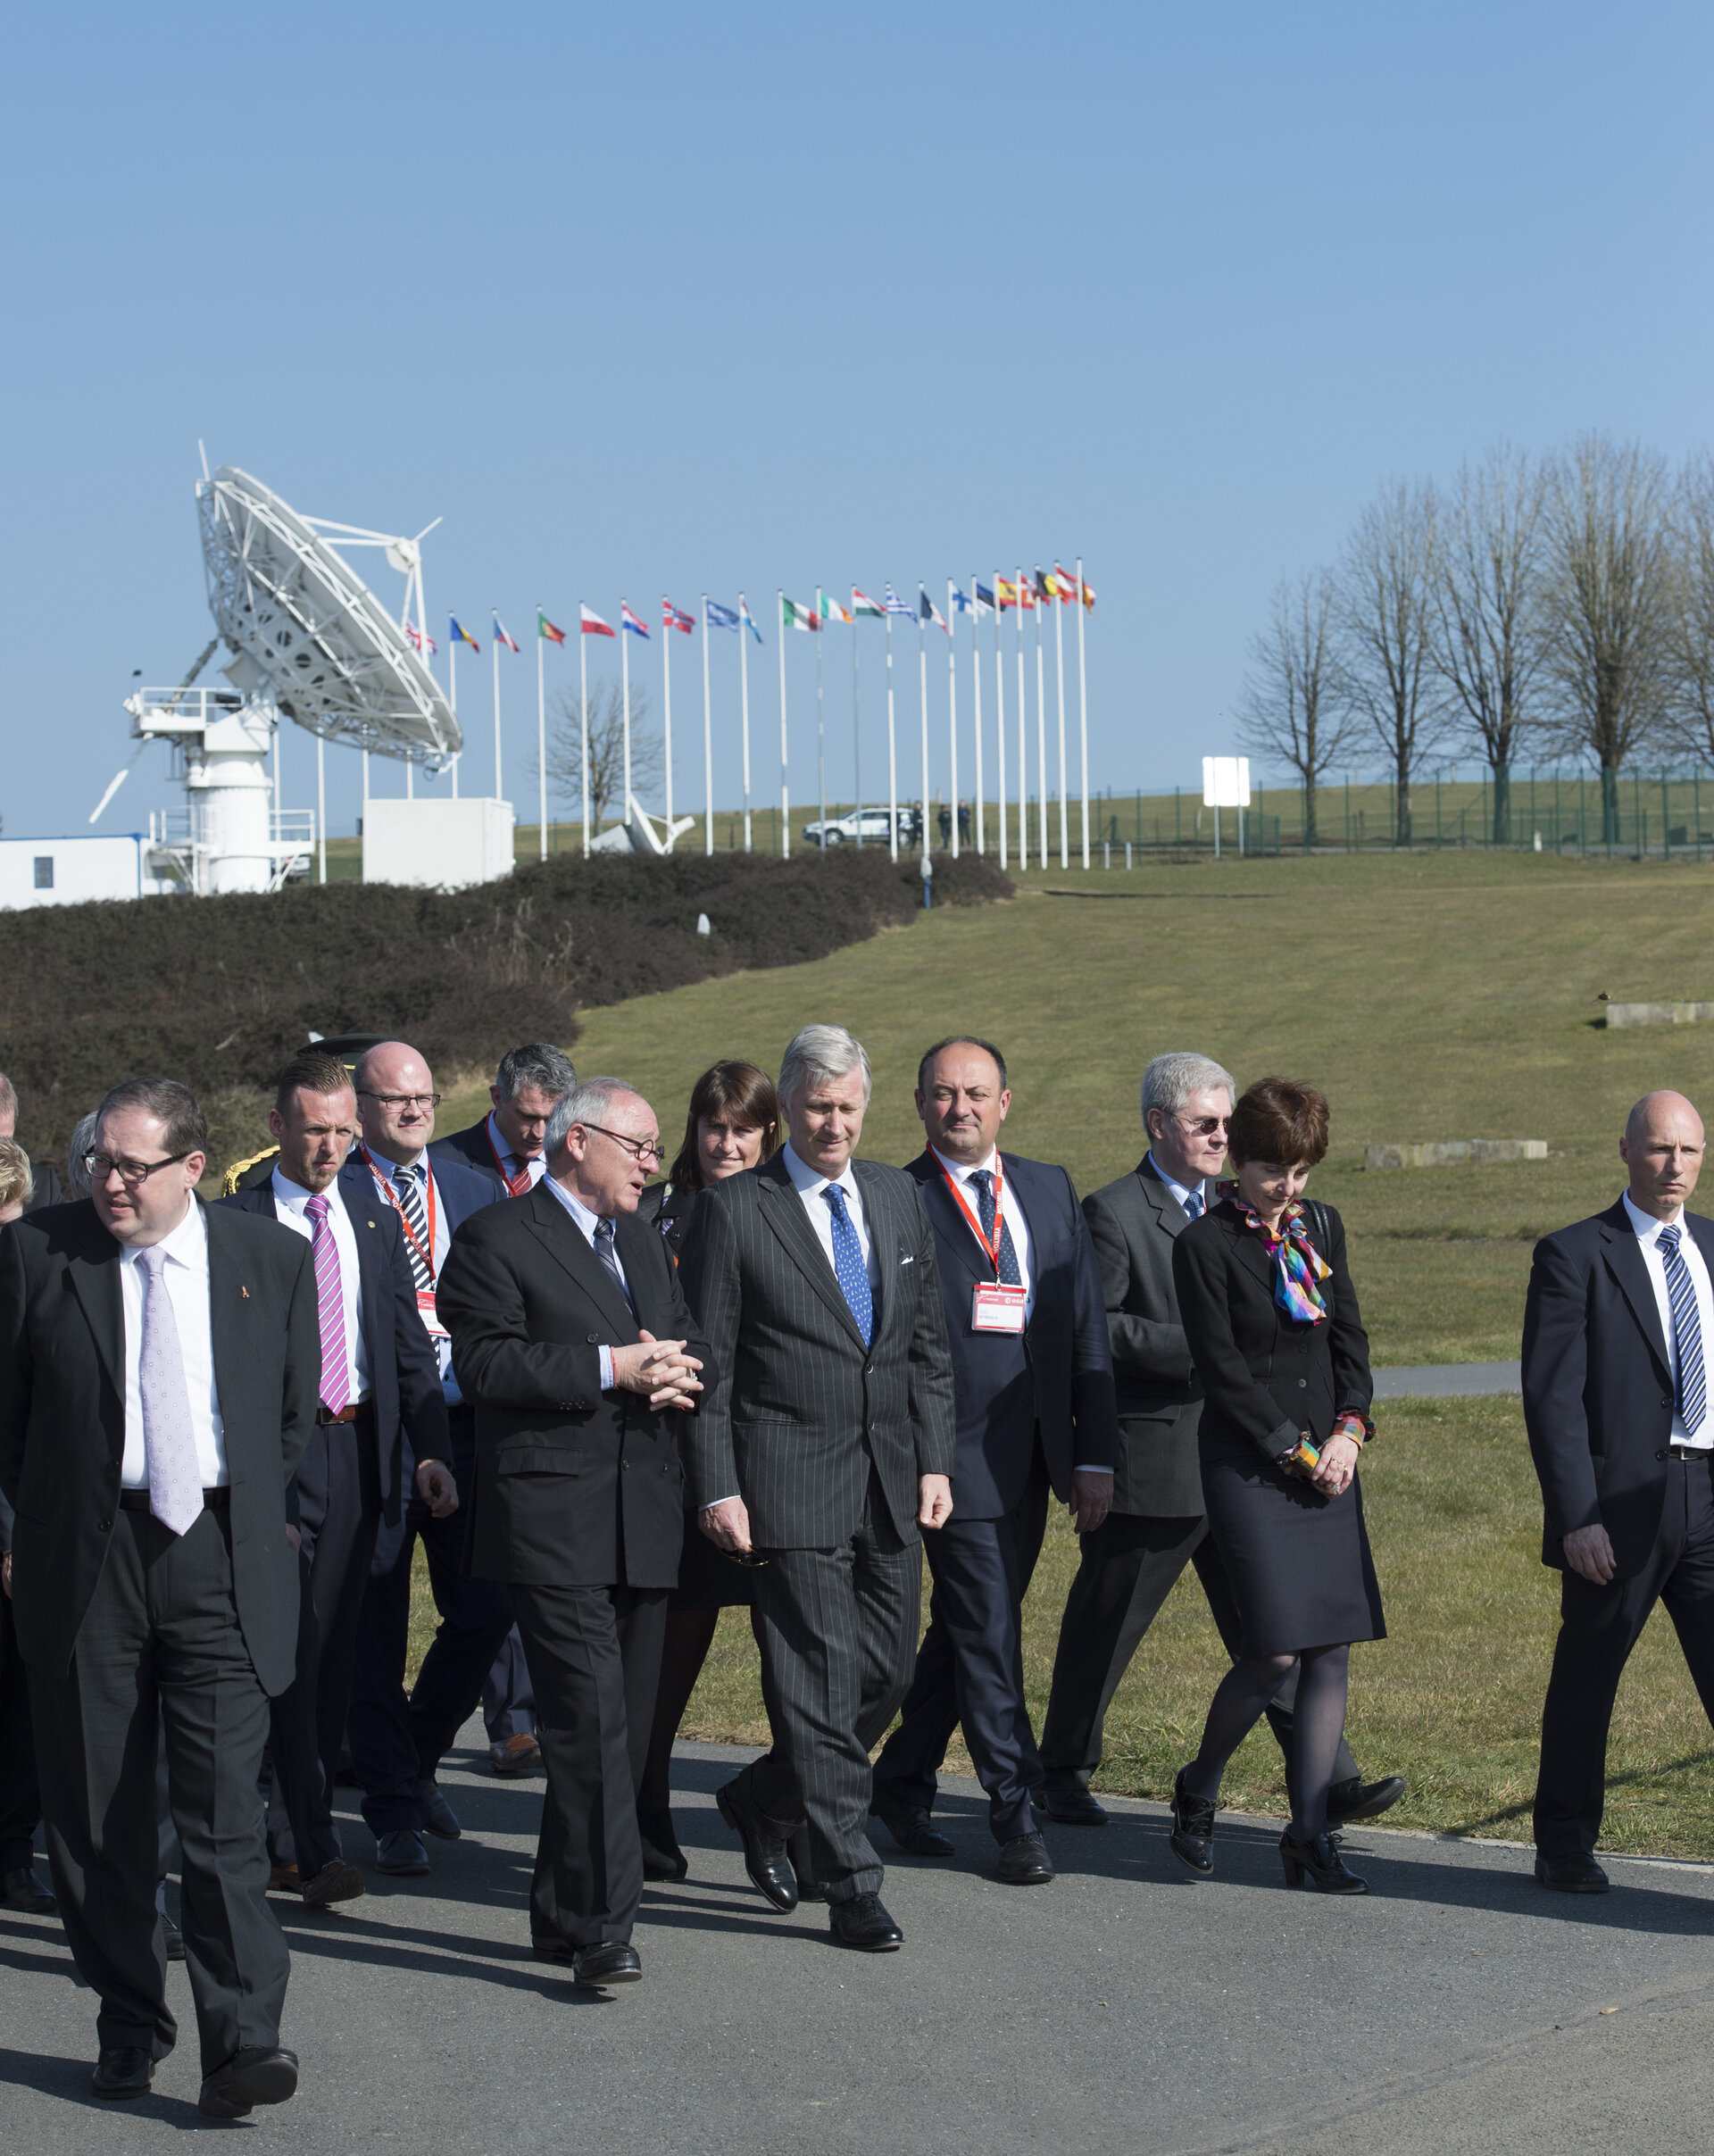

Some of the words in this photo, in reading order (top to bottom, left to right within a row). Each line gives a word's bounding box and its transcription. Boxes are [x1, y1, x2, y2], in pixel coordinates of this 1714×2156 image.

[368, 1161, 387, 1187] VISITOR
[391, 1196, 407, 1224] VISITOR
[410, 1236, 428, 1262] VISITOR
[993, 1227, 1001, 1253] VISITOR
